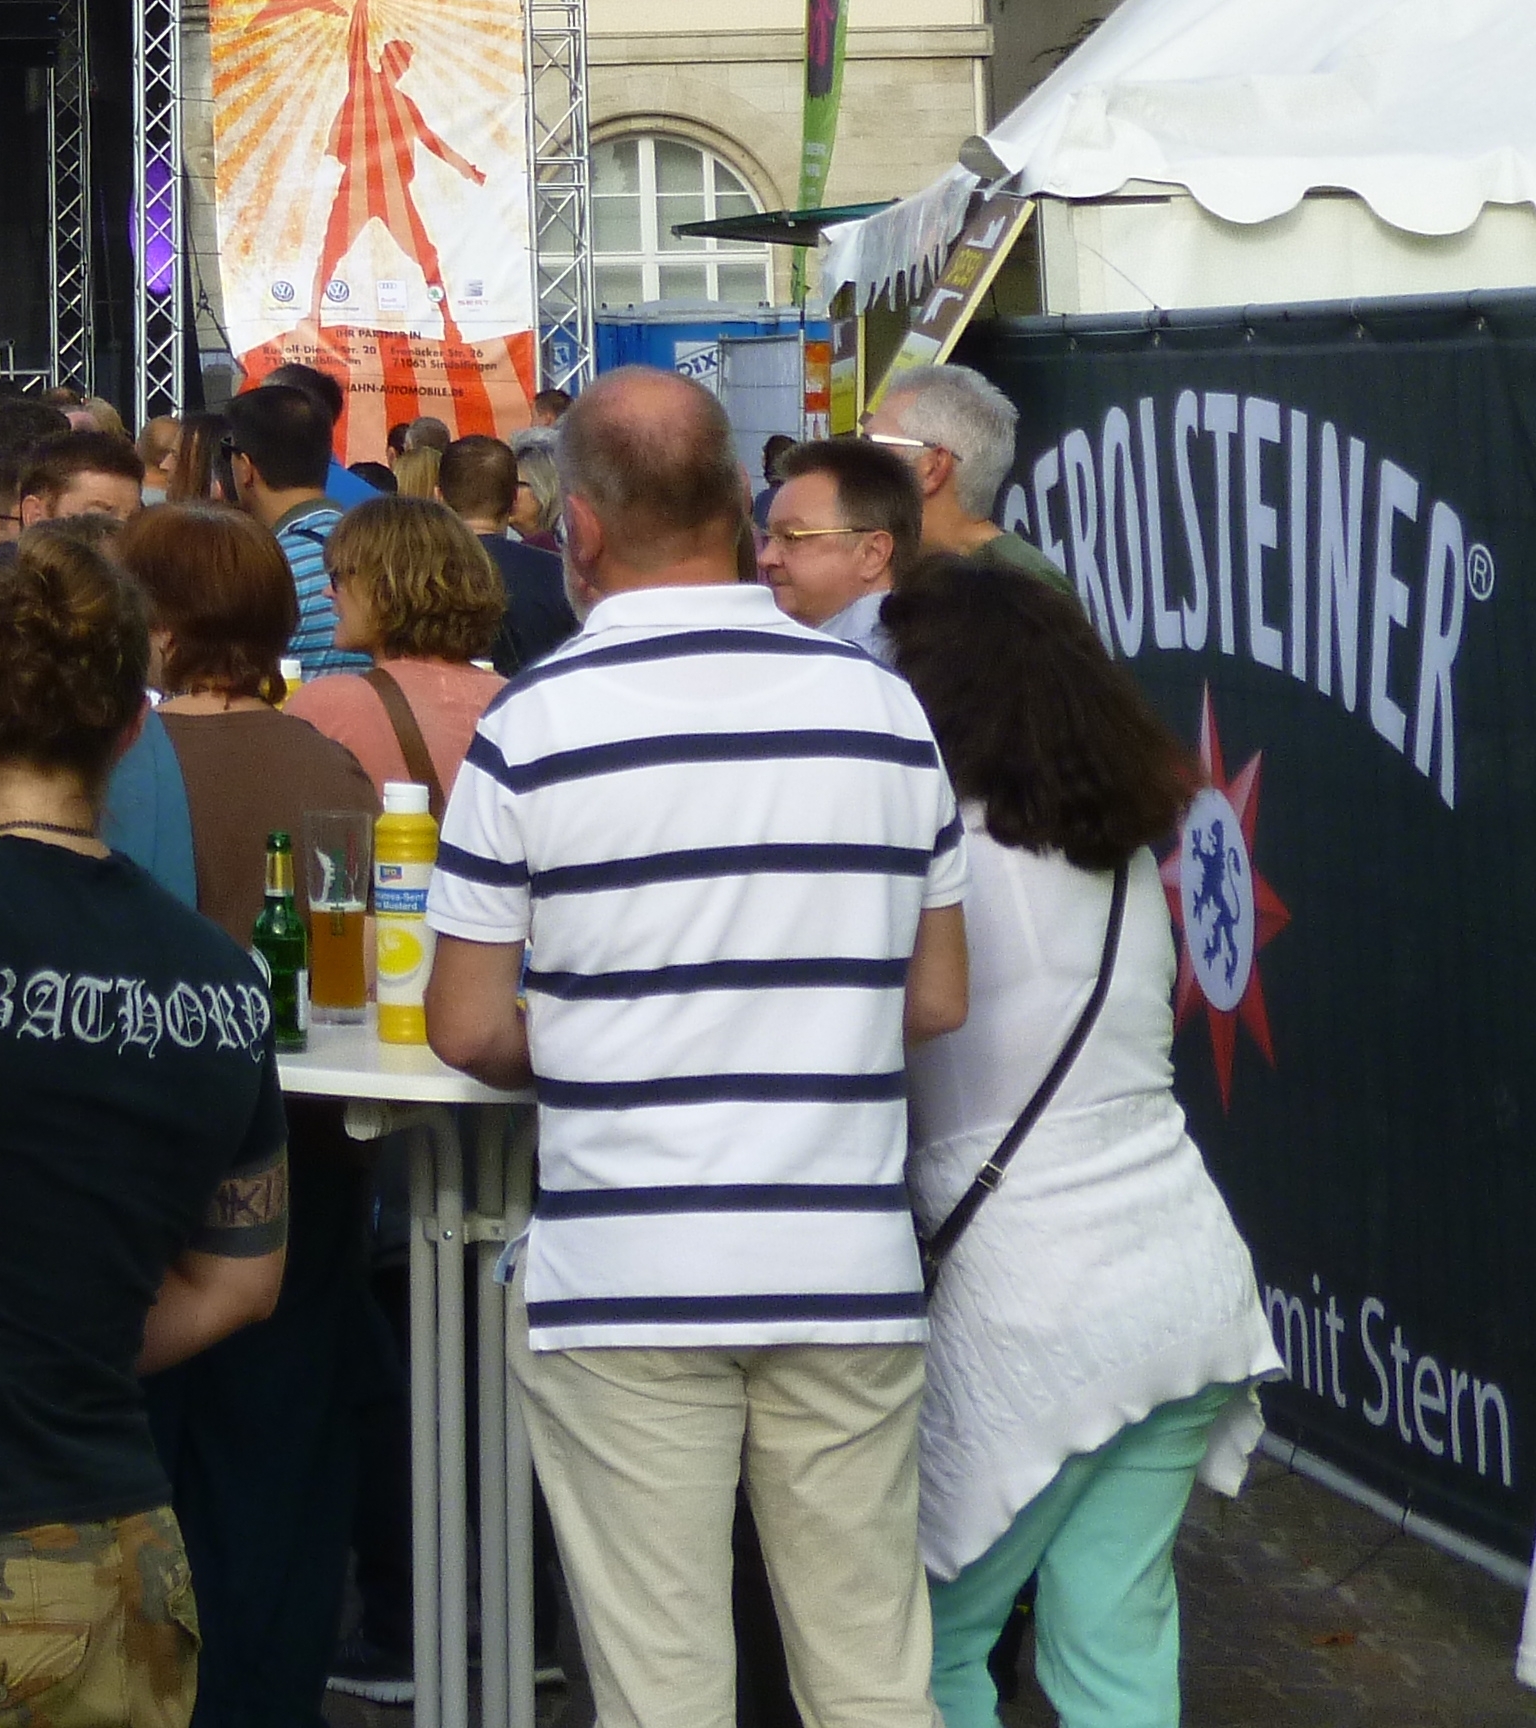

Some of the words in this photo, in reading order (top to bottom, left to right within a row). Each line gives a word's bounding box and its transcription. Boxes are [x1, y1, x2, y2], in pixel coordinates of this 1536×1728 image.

[336, 329, 355, 339] IHR
[409, 331, 422, 341] IN
[1265, 1273, 1347, 1410] mit
[1360, 1296, 1512, 1488] Stern
